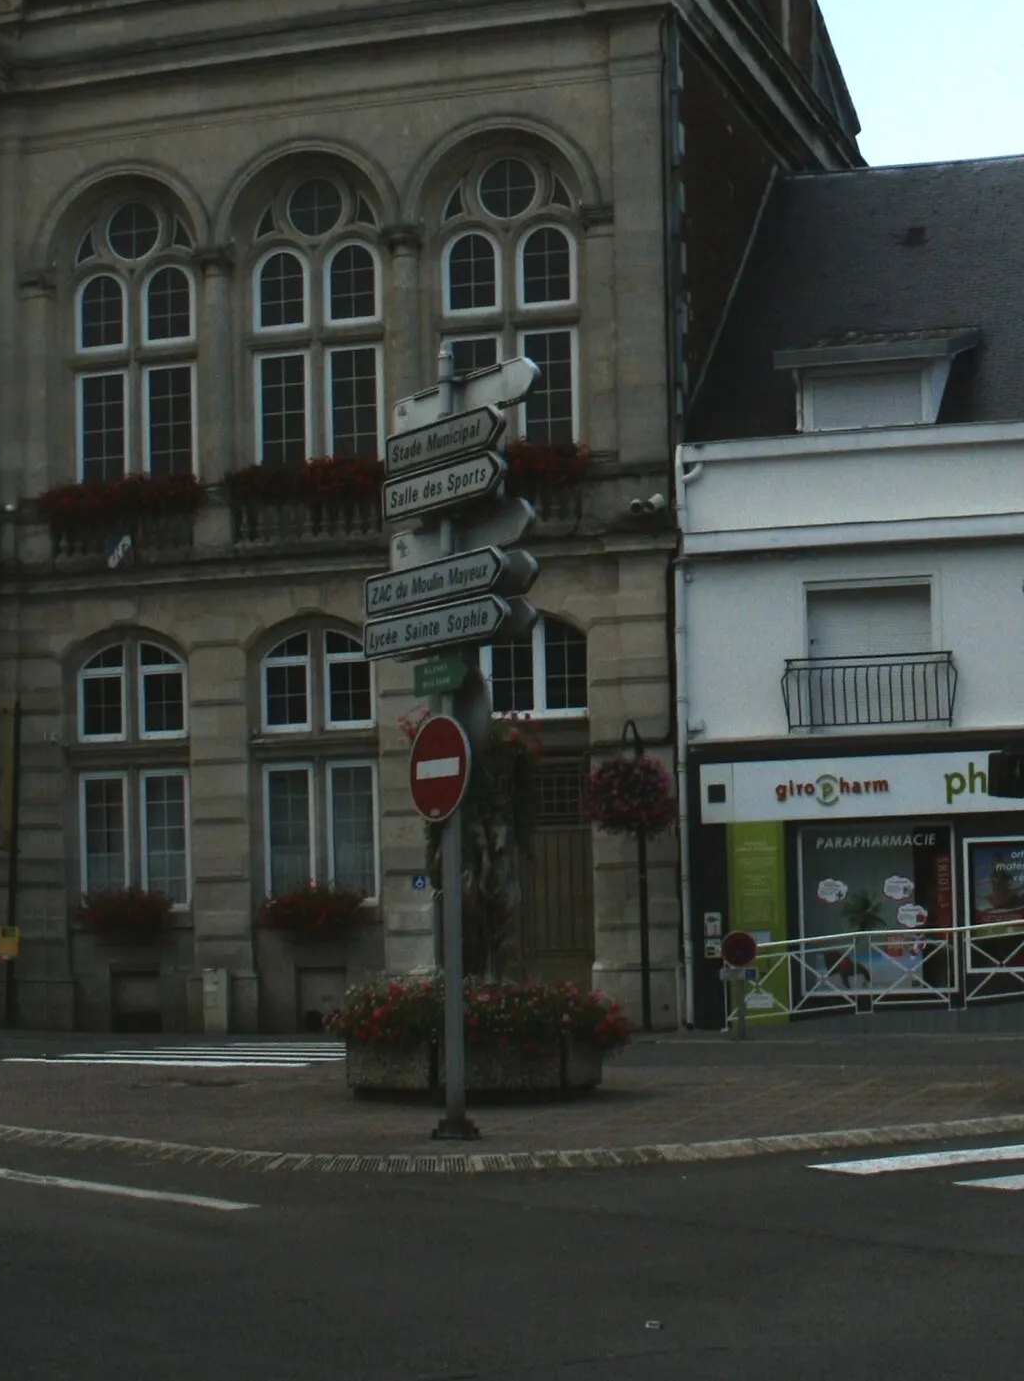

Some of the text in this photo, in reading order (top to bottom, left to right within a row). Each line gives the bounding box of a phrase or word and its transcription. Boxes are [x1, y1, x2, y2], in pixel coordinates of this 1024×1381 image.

[391, 419, 480, 463] Stade Municipal
[390, 468, 486, 509] Salle des Sports
[372, 564, 488, 605] ZAC du Moulin Mayeux
[369, 610, 488, 649] Lycée Sainte Sophie
[816, 833, 937, 850] PARAPHARMACIE
